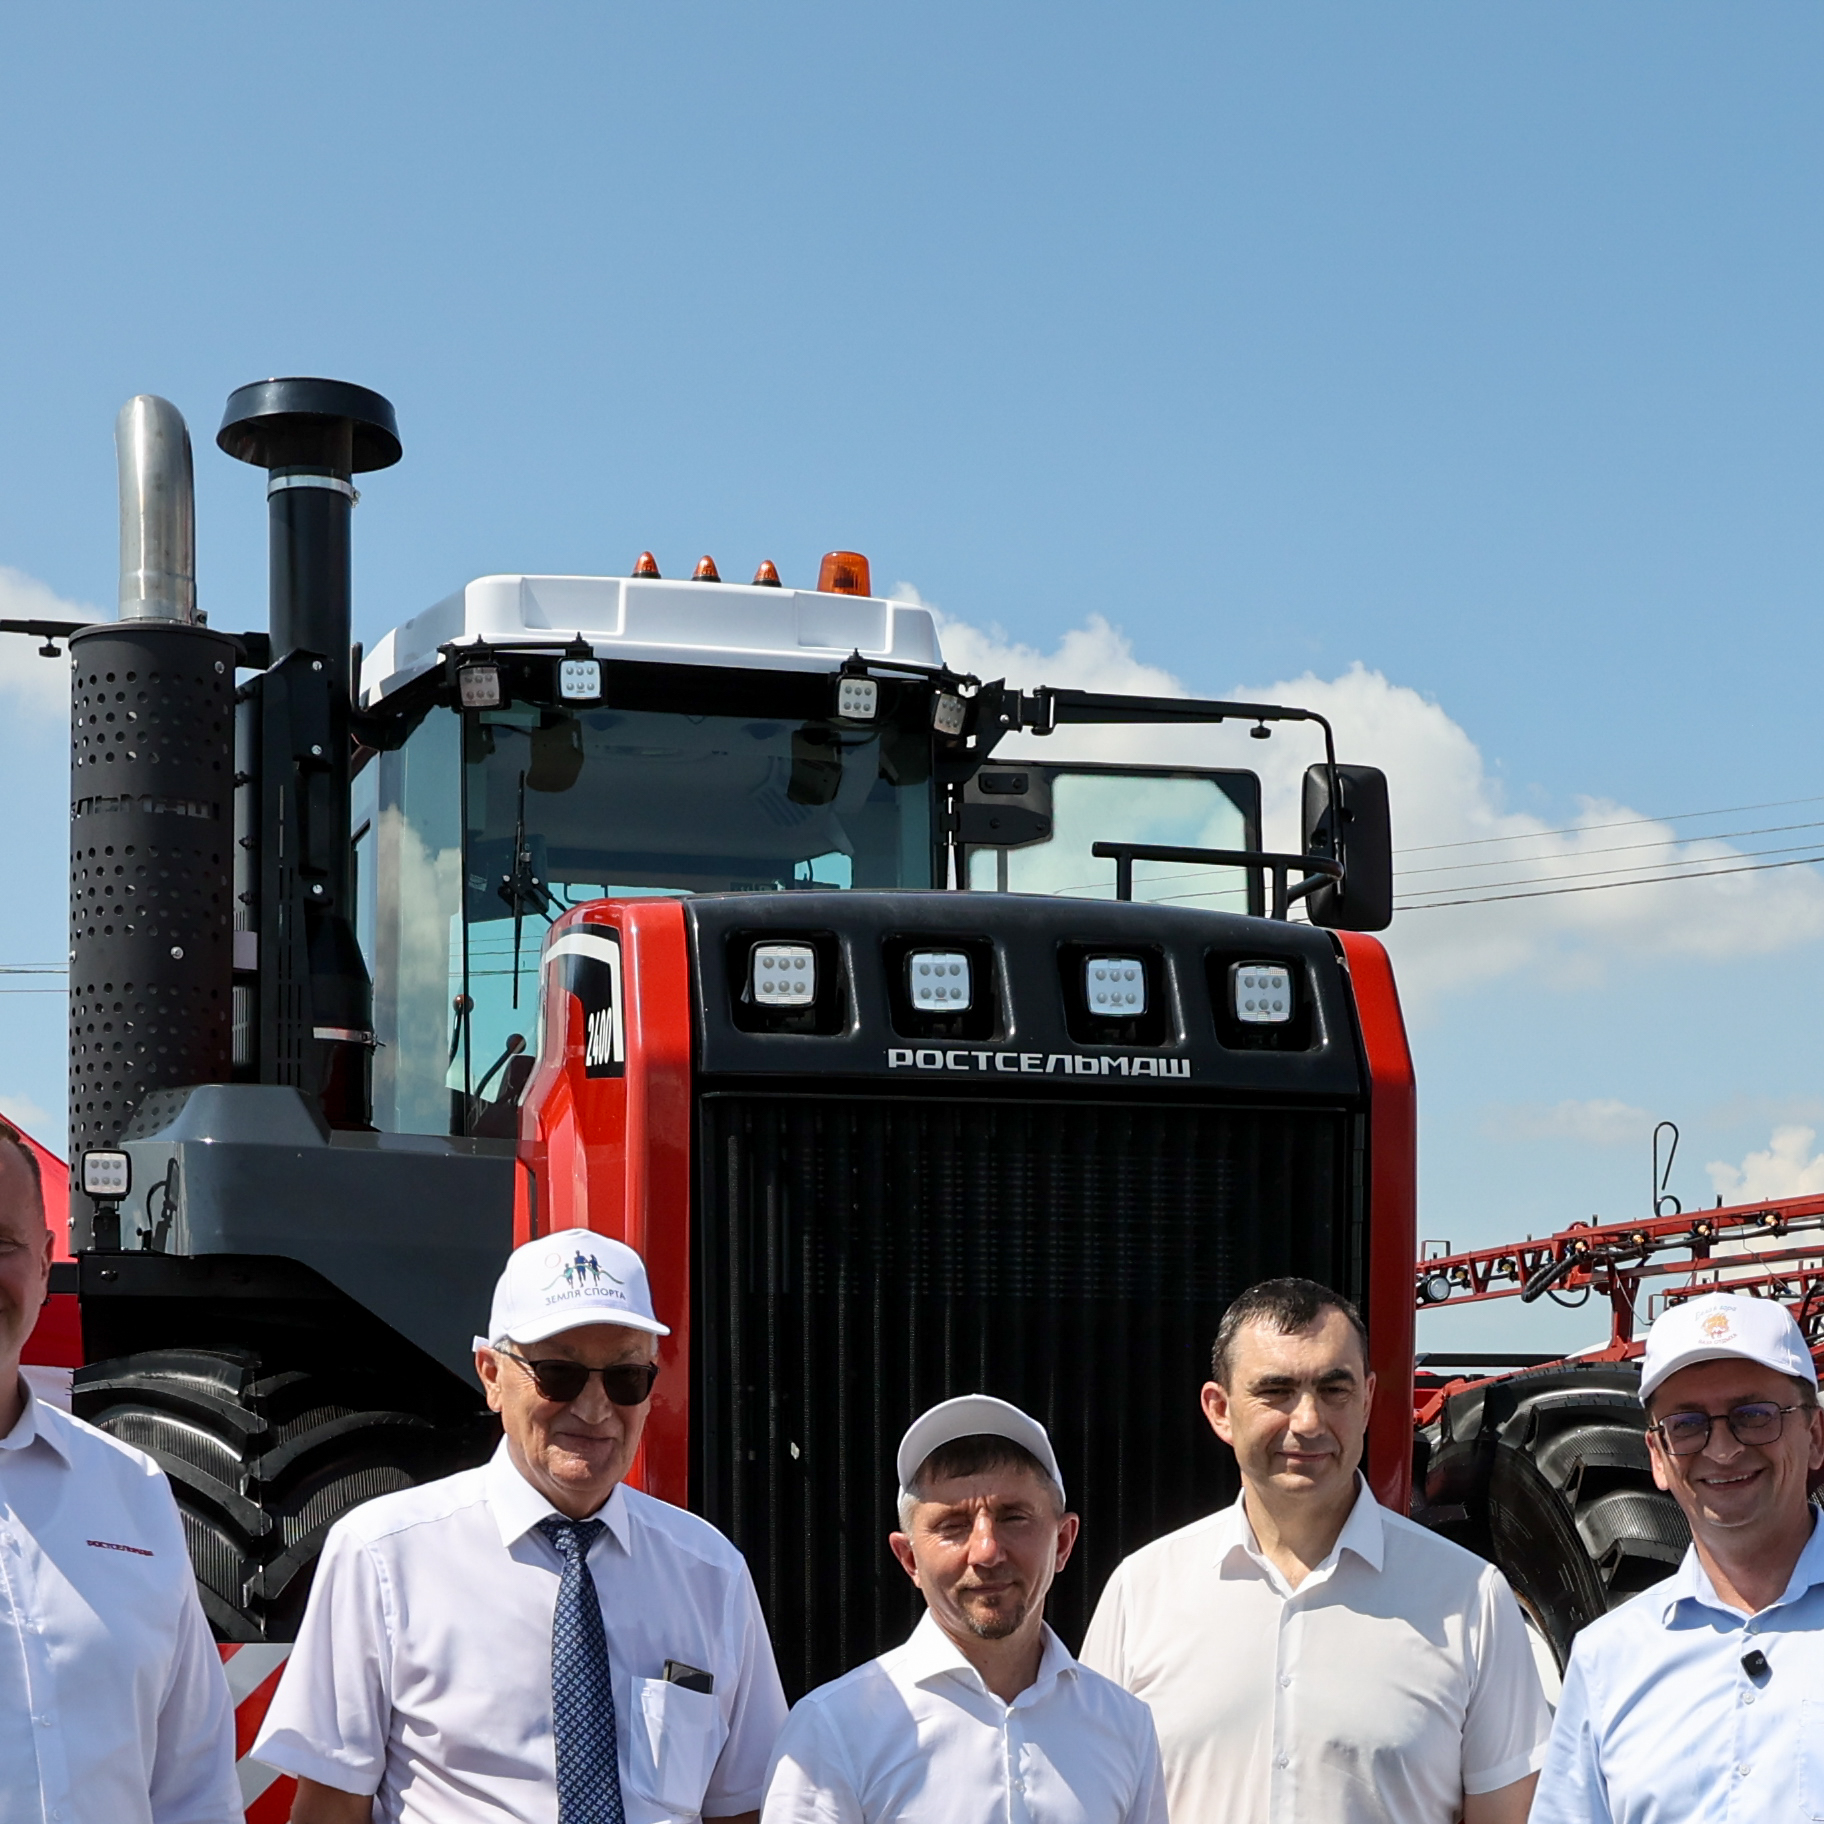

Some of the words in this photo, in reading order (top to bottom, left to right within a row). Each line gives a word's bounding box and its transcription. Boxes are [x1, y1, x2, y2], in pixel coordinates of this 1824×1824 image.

[586, 1006, 612, 1067] 2400
[887, 1048, 1191, 1078] РОСТСЕЛЬМАШ
[545, 1289, 581, 1306] ЗЕМЛЯ
[584, 1287, 626, 1301] СПОРТА
